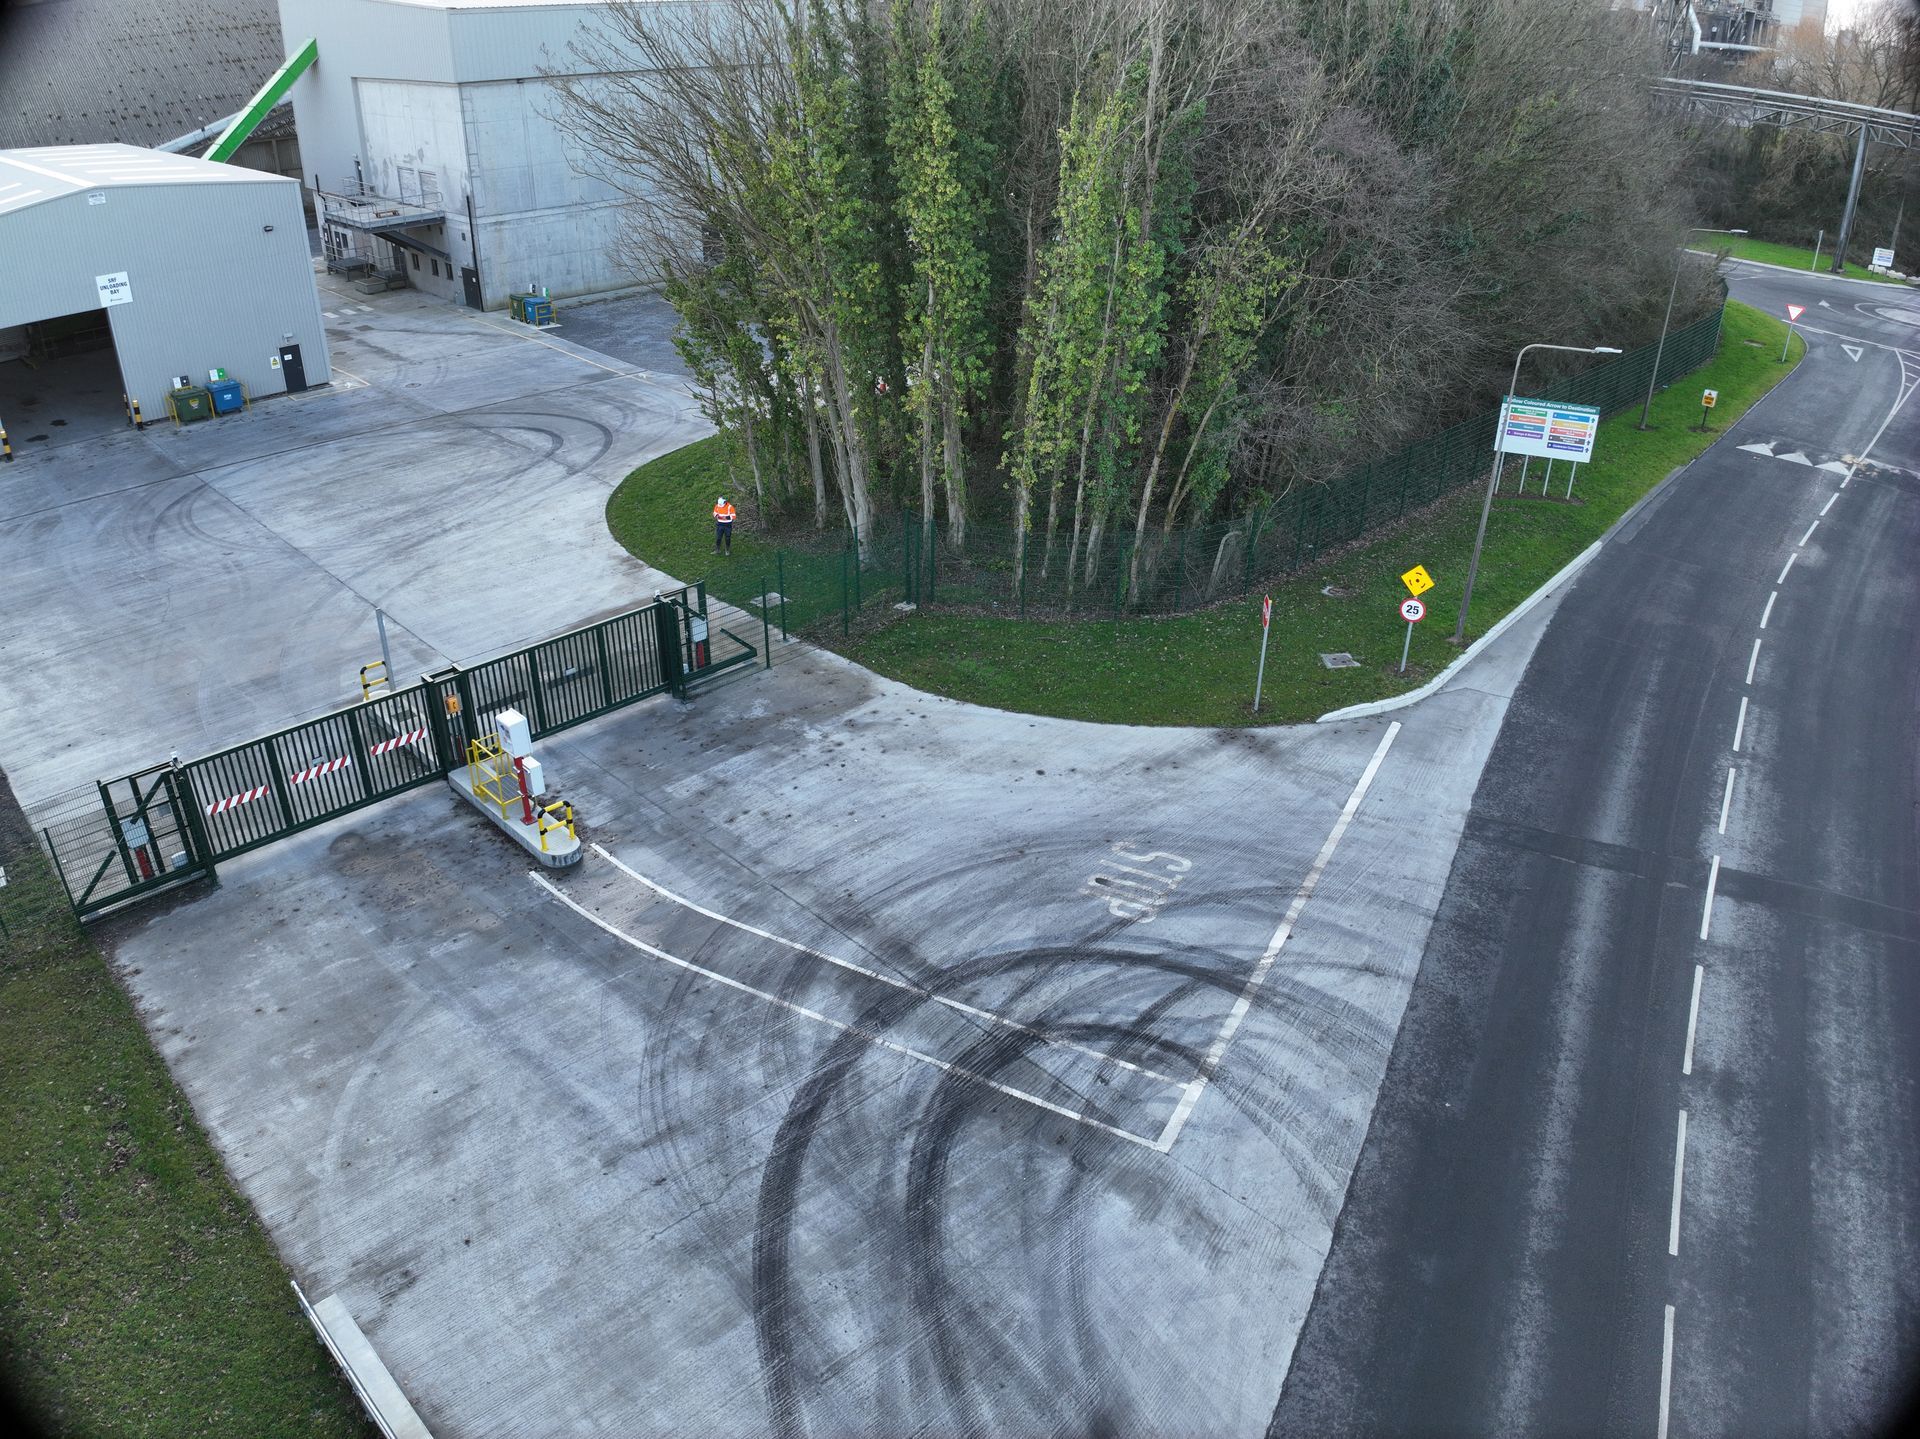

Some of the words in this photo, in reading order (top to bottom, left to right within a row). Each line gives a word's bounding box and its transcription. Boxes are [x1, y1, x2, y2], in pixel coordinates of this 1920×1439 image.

[100, 281, 128, 291] UNLOADING
[1568, 404, 1596, 413] Destination
[1406, 604, 1419, 615] 25
